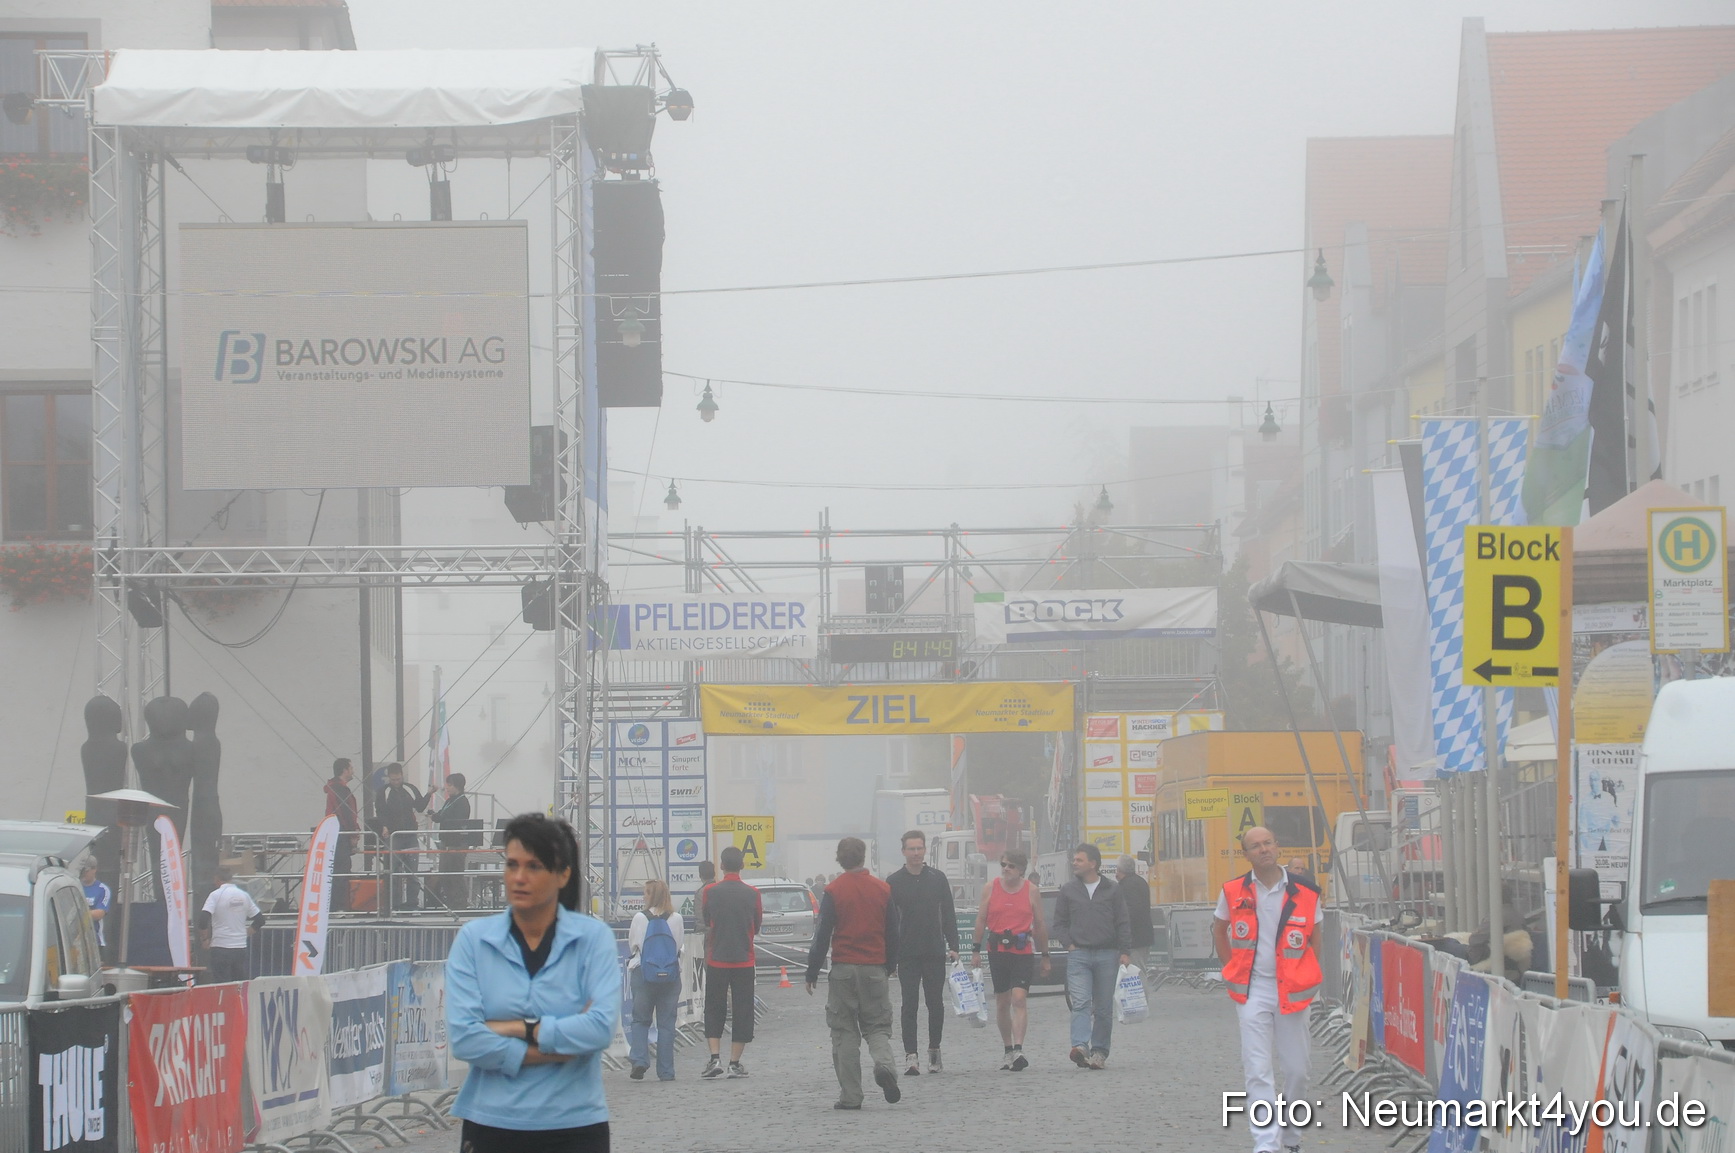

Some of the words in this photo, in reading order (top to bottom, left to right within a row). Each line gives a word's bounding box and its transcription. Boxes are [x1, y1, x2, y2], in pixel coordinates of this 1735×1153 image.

[275, 338, 447, 366] BAROWSKI
[458, 336, 505, 364] AG
[277, 368, 374, 382] Veranstaltungs-
[379, 368, 401, 380] und
[407, 368, 504, 382] Mediensysteme
[1477, 532, 1560, 561] Block
[1674, 530, 1700, 560] H
[1663, 579, 1713, 588] Marktplatz
[635, 601, 806, 632] PFLEIDERER
[1004, 598, 1125, 625] BOCK
[1491, 574, 1545, 651] B
[636, 634, 807, 651] AKTIENGESELLSCHAFT
[720, 709, 764, 719] Neumarkter
[765, 710, 800, 721] Stadtlauf
[846, 694, 930, 725] ZIEL
[975, 708, 1019, 718] Neumarkter
[1020, 707, 1055, 717] Stadtlauf
[618, 756, 647, 767] MCM
[672, 755, 701, 764] Sinupret
[672, 763, 689, 771] forte
[670, 787, 693, 796] swn
[1187, 797, 1227, 806] Schnupper-
[1234, 794, 1260, 804] Block
[737, 821, 763, 831] Block
[1238, 807, 1257, 831] A
[741, 835, 759, 859] A
[671, 873, 694, 881] MCM
[37, 1044, 106, 1152] THULE
